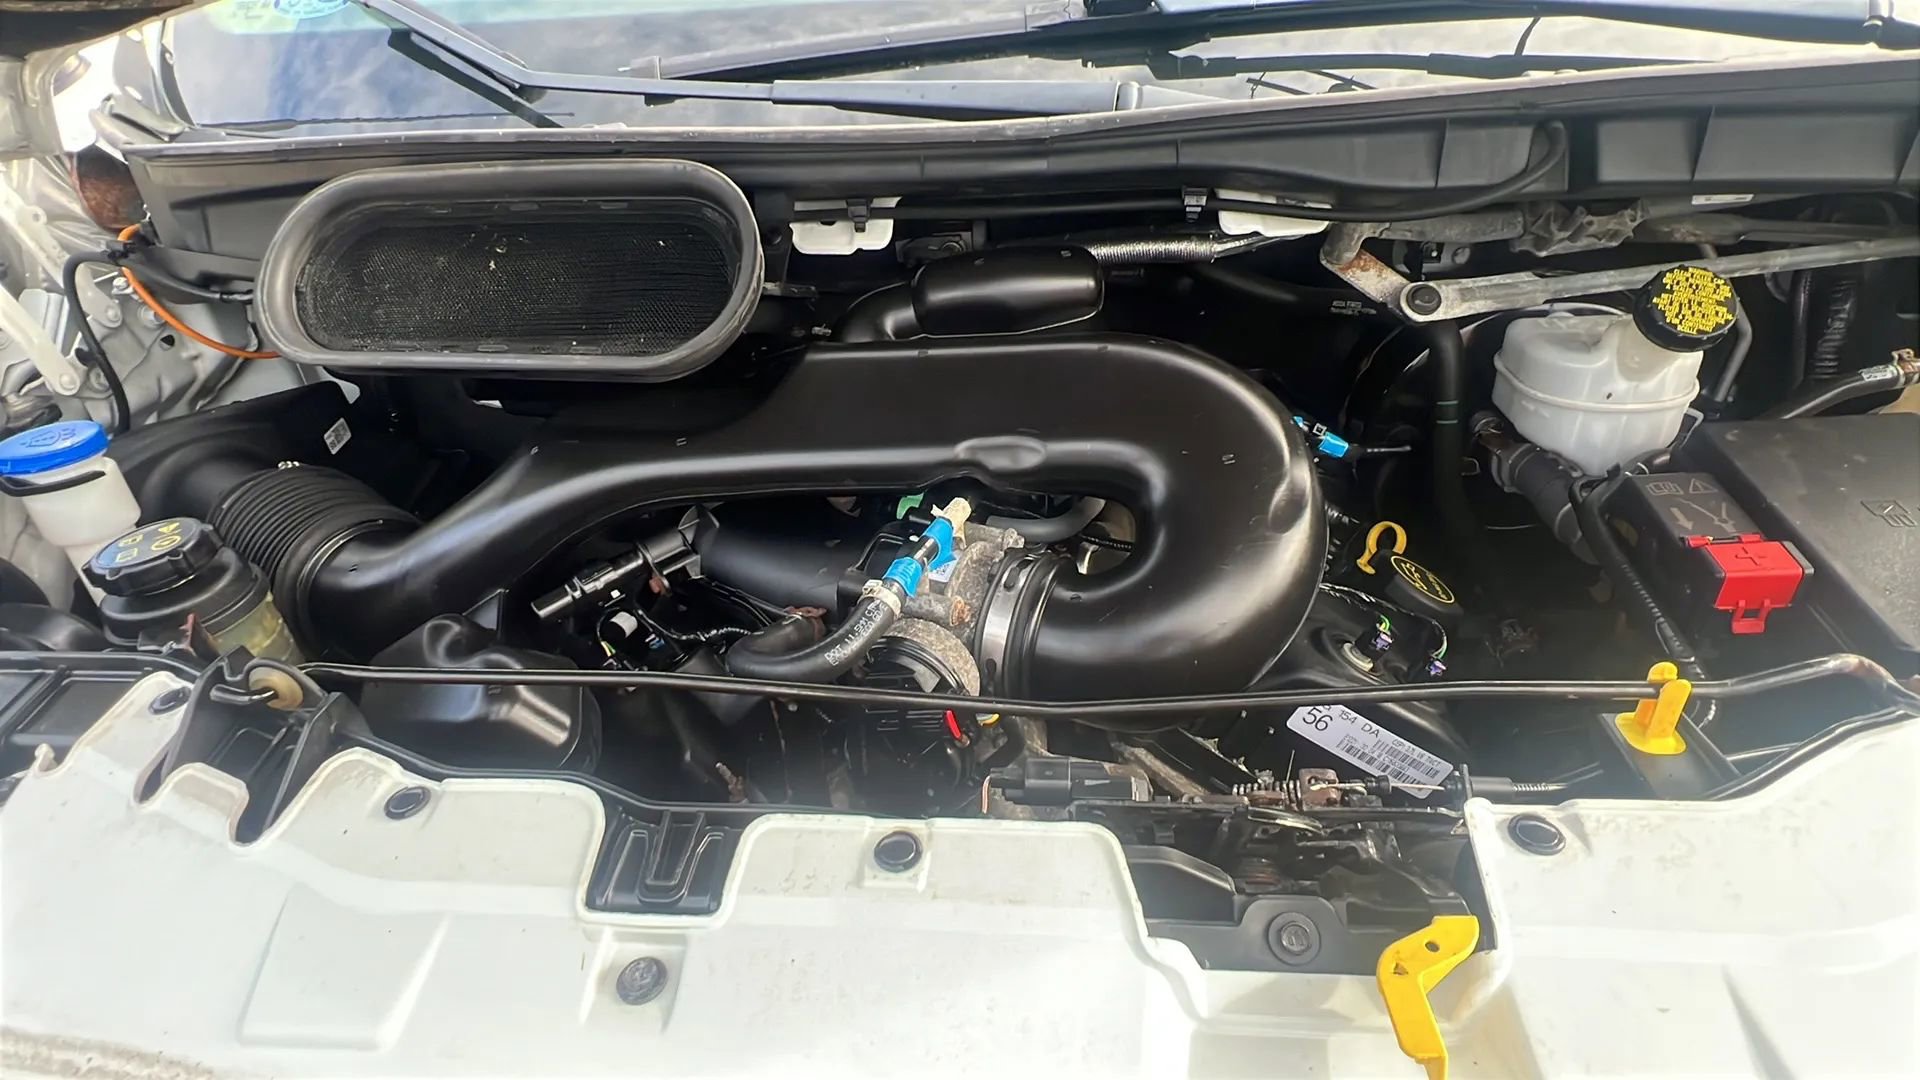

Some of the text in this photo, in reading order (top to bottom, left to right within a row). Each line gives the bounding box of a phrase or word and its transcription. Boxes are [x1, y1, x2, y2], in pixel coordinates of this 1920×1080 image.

[1302, 707, 1333, 731] 56
[1339, 710, 1380, 738] 154 DA
